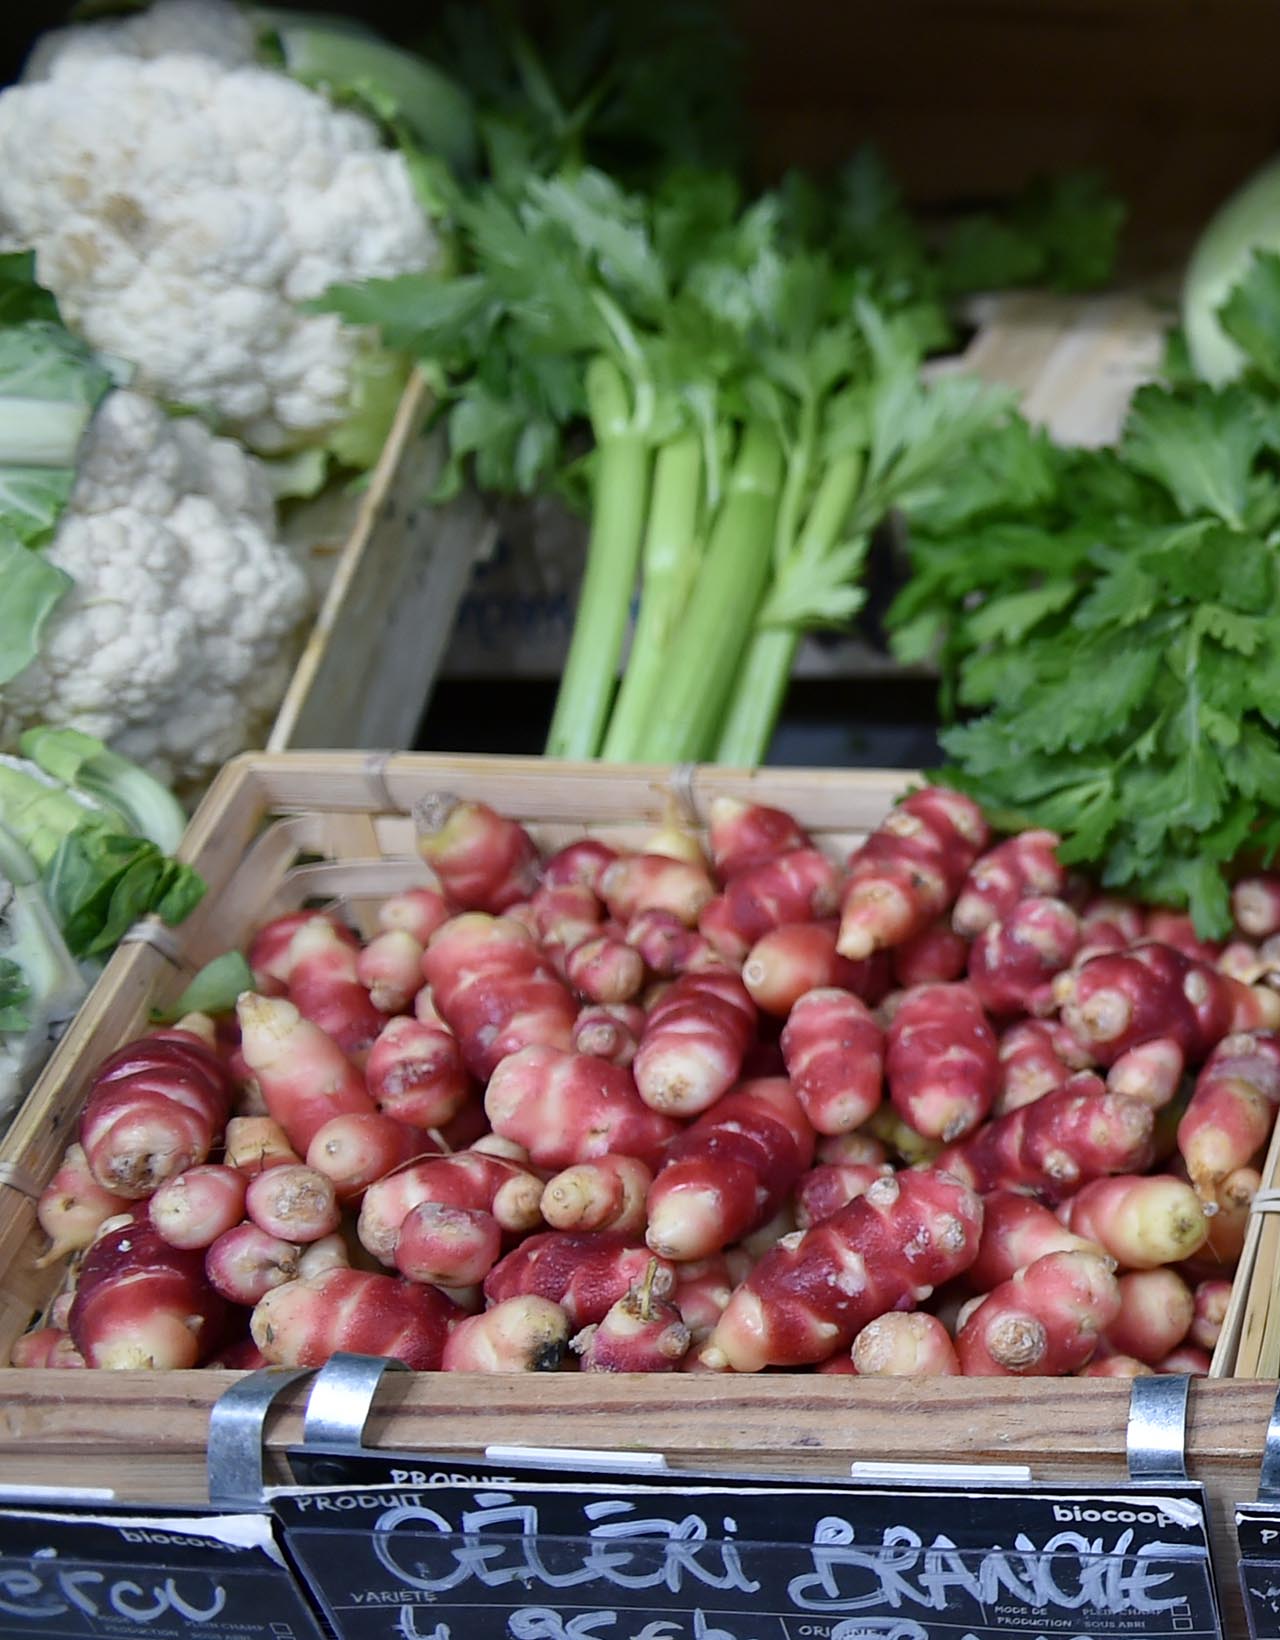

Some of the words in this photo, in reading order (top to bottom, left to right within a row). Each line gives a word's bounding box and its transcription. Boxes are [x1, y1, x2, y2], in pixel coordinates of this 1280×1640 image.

[295, 1493, 424, 1512] PRODUIT
[1053, 1505, 1176, 1528] biocoop
[787, 1515, 1209, 1613] BRANCHE
[997, 1616, 1073, 1628] PRODUCTION
